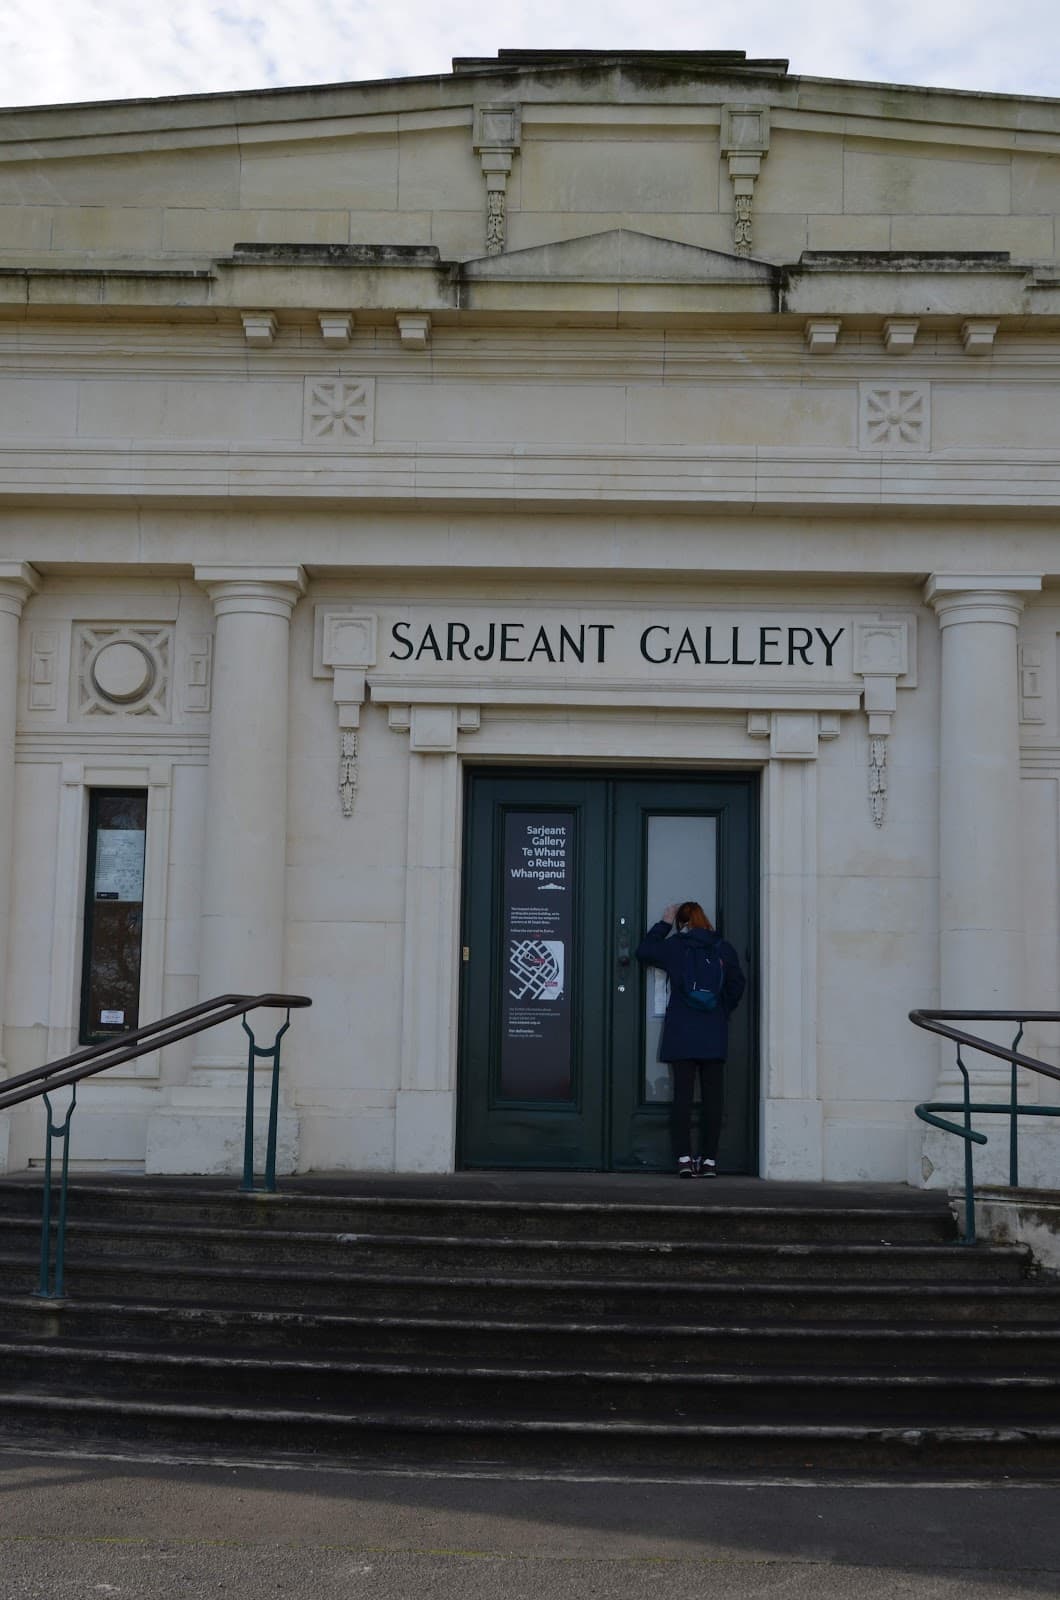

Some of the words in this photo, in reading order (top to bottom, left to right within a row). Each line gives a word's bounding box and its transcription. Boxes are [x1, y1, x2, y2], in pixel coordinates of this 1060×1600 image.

[389, 621, 615, 664] SARJEANT
[639, 625, 846, 667] GALLERY
[527, 825, 566, 837] Sarjeant
[532, 836, 566, 848] Gallery
[522, 847, 533, 857] Te
[534, 847, 566, 857] Whare
[527, 860, 535, 868] o
[535, 858, 566, 868] Rehua
[510, 868, 566, 880] Whanganui
